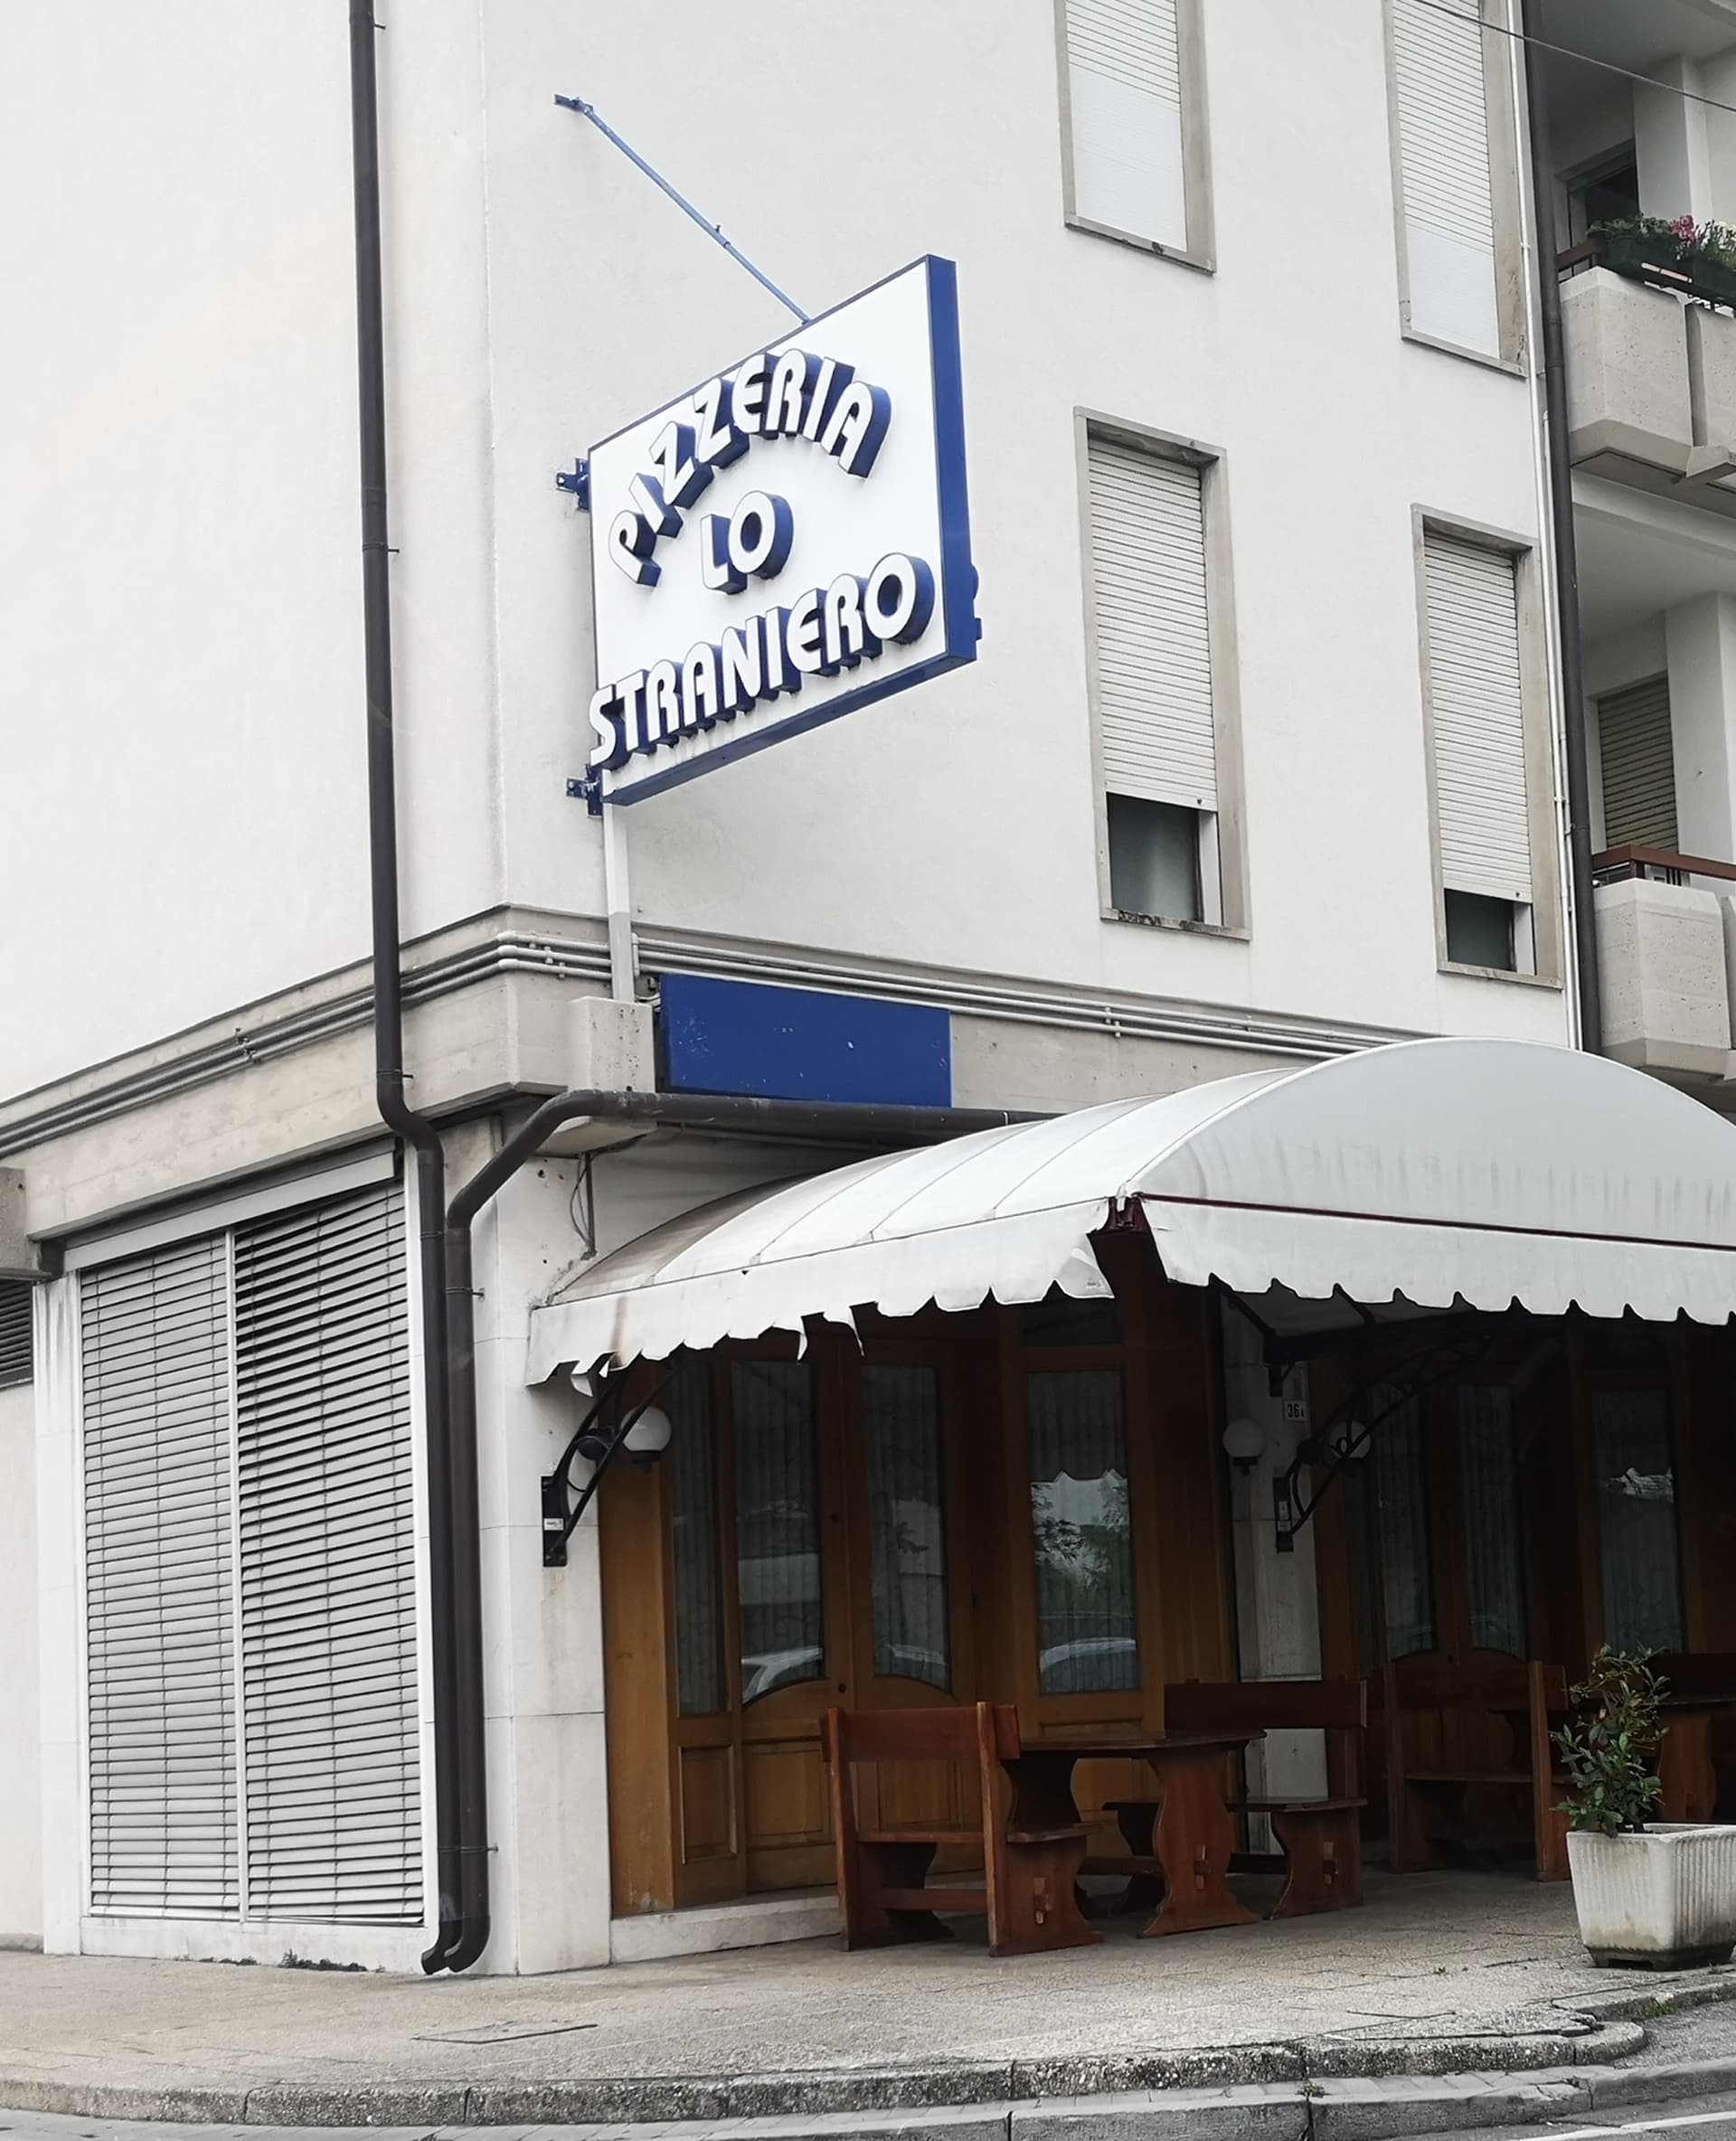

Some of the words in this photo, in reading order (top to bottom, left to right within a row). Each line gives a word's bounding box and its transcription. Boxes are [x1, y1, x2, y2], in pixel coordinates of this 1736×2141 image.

[609, 348, 888, 586] PIZZERIA
[701, 490, 790, 594] LO
[589, 552, 930, 769] STRANIERO
